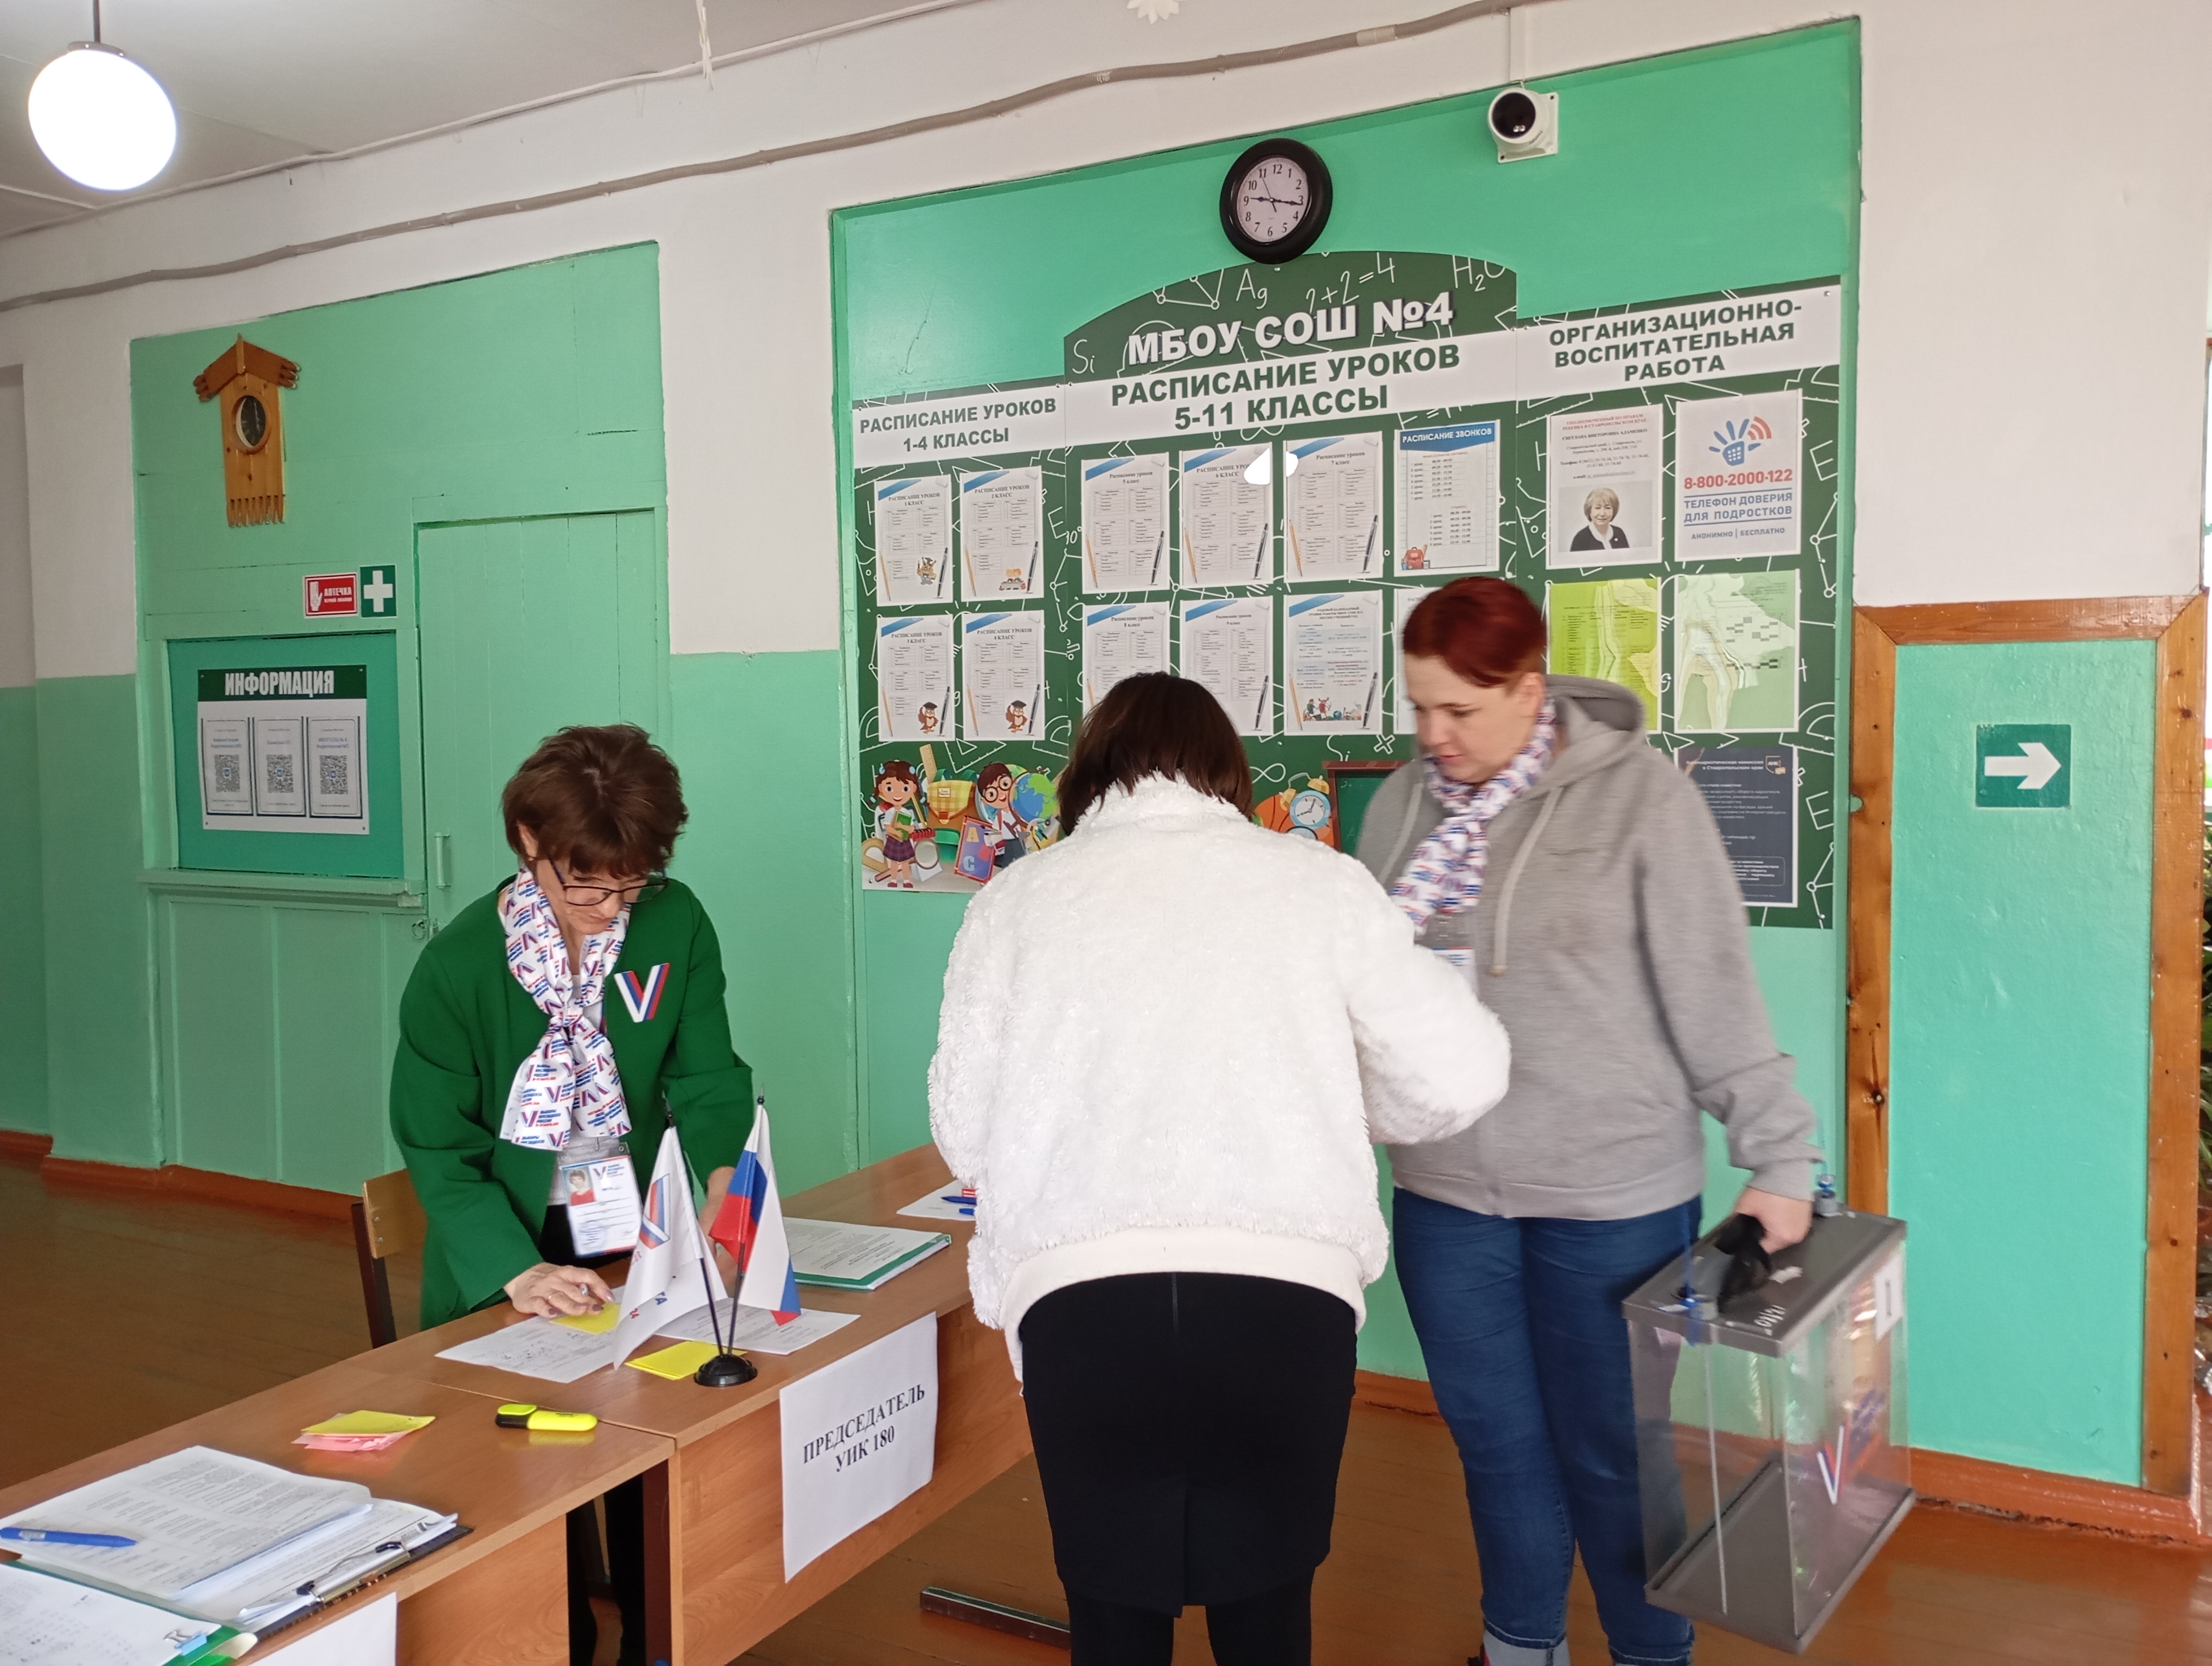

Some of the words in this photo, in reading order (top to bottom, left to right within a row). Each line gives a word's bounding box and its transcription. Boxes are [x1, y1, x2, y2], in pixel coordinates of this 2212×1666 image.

[1259, 168, 1267, 178] 11
[1272, 164, 1283, 175] 12
[1288, 168, 1292, 178] 1
[1248, 180, 1257, 190] 10
[1296, 180, 1302, 190] 2
[1244, 196, 1249, 207] 9
[1245, 212, 1251, 222] 8
[1293, 211, 1299, 221] 4
[1254, 222, 1261, 233] 7
[1267, 226, 1273, 237] 6
[1282, 223, 1288, 233] 5
[1236, 268, 1268, 310] Ag
[1128, 321, 1242, 366] МБОУ
[1255, 304, 1357, 349] СОШ
[1373, 291, 1454, 335] №4
[1549, 299, 1802, 346] ОРГАНИЗАЦИОННО-
[1555, 322, 1795, 368] ВОСПИТАТЕЛЬНАЯ
[1072, 339, 1095, 374] Si
[1111, 361, 1317, 406] РАСПИСАНИЕ
[1327, 344, 1460, 381] УРОКОВ
[1624, 355, 1726, 381] РАБОТА
[860, 406, 978, 433] РАСПИСАНИЕ
[982, 398, 1057, 420] УРОКОВ
[1174, 401, 1233, 430] 5-11
[1247, 385, 1388, 422] КЛАССЫ
[903, 436, 928, 452] 1-4
[933, 427, 1009, 450] КЛАССЫ
[1401, 432, 1454, 444] РАСПИСАНИЕ
[1455, 427, 1493, 438] ЗВОНКОВ
[1197, 465, 1234, 473] РАСПИСАНИЕ
[1683, 468, 1793, 489] 8-800-2000-122
[1683, 497, 1737, 509] ТЕЛЕФОН
[1739, 492, 1792, 507] ДОВЕРИЯ
[1684, 512, 1708, 523] ДЛЯ
[1714, 506, 1792, 520] ПОДРОСТКОВ
[1691, 531, 1733, 540] АНОНИМНО
[1740, 527, 1785, 536] БЕСПЛАТНО
[224, 670, 335, 698] ИНФОРМАЦИЯ
[963, 855, 975, 872] C
[802, 1383, 925, 1464] ПРЕДСЕДАТЕЛЬ
[835, 1438, 870, 1473] УИК
[873, 1425, 895, 1452] 180
